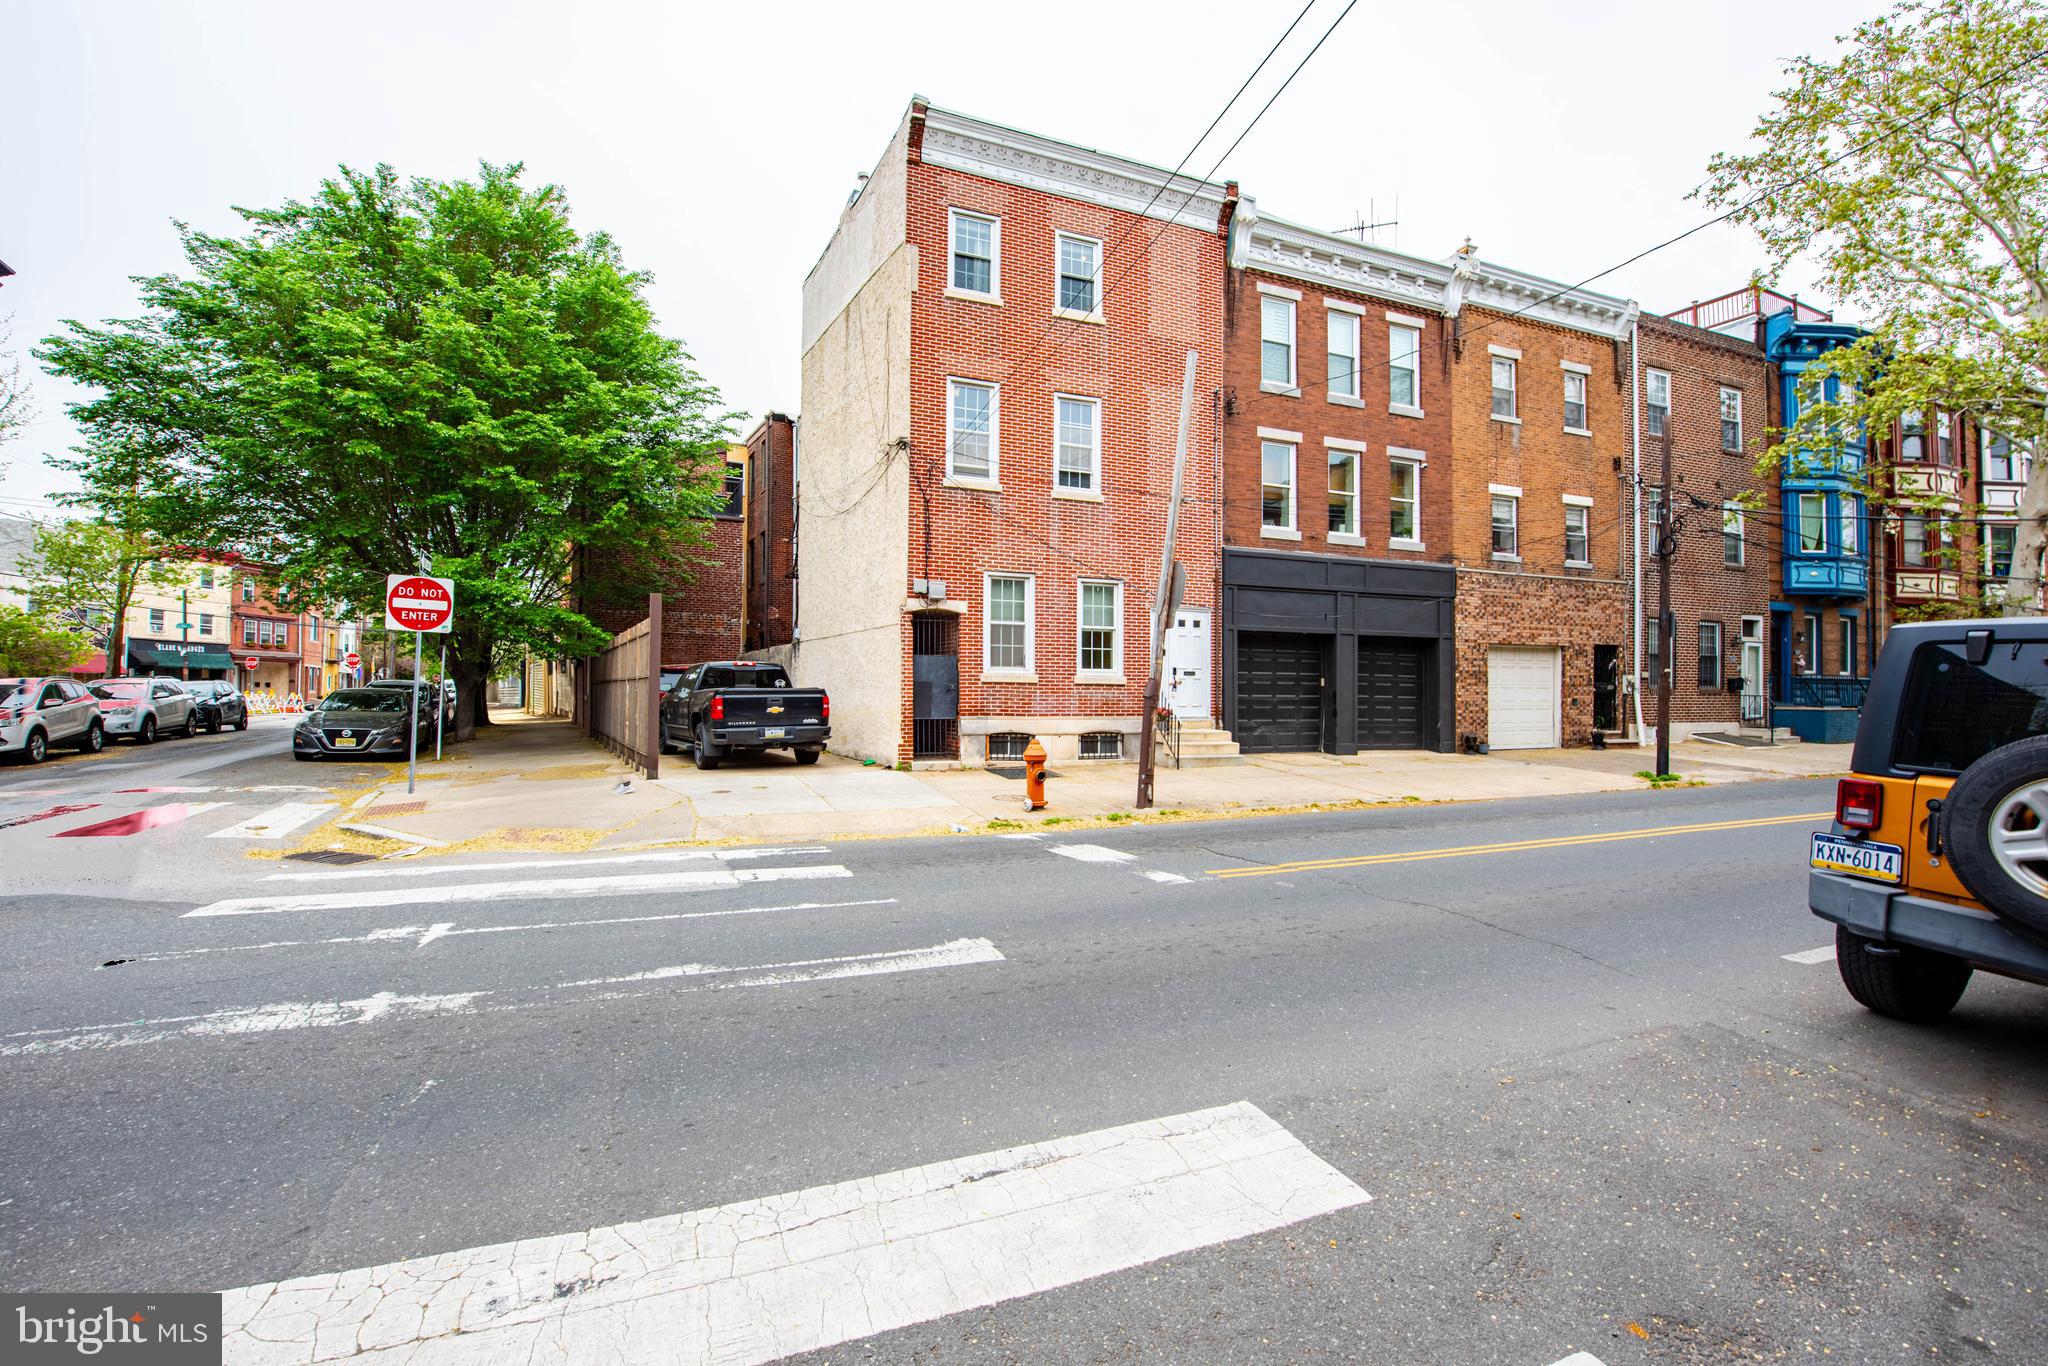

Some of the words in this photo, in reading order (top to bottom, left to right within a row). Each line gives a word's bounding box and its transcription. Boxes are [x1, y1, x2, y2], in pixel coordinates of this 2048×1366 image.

[398, 586, 415, 596] DO
[421, 588, 444, 598] NOT
[401, 610, 438, 622] ENTER
[1834, 838, 1878, 850] PENNSYLVANIA
